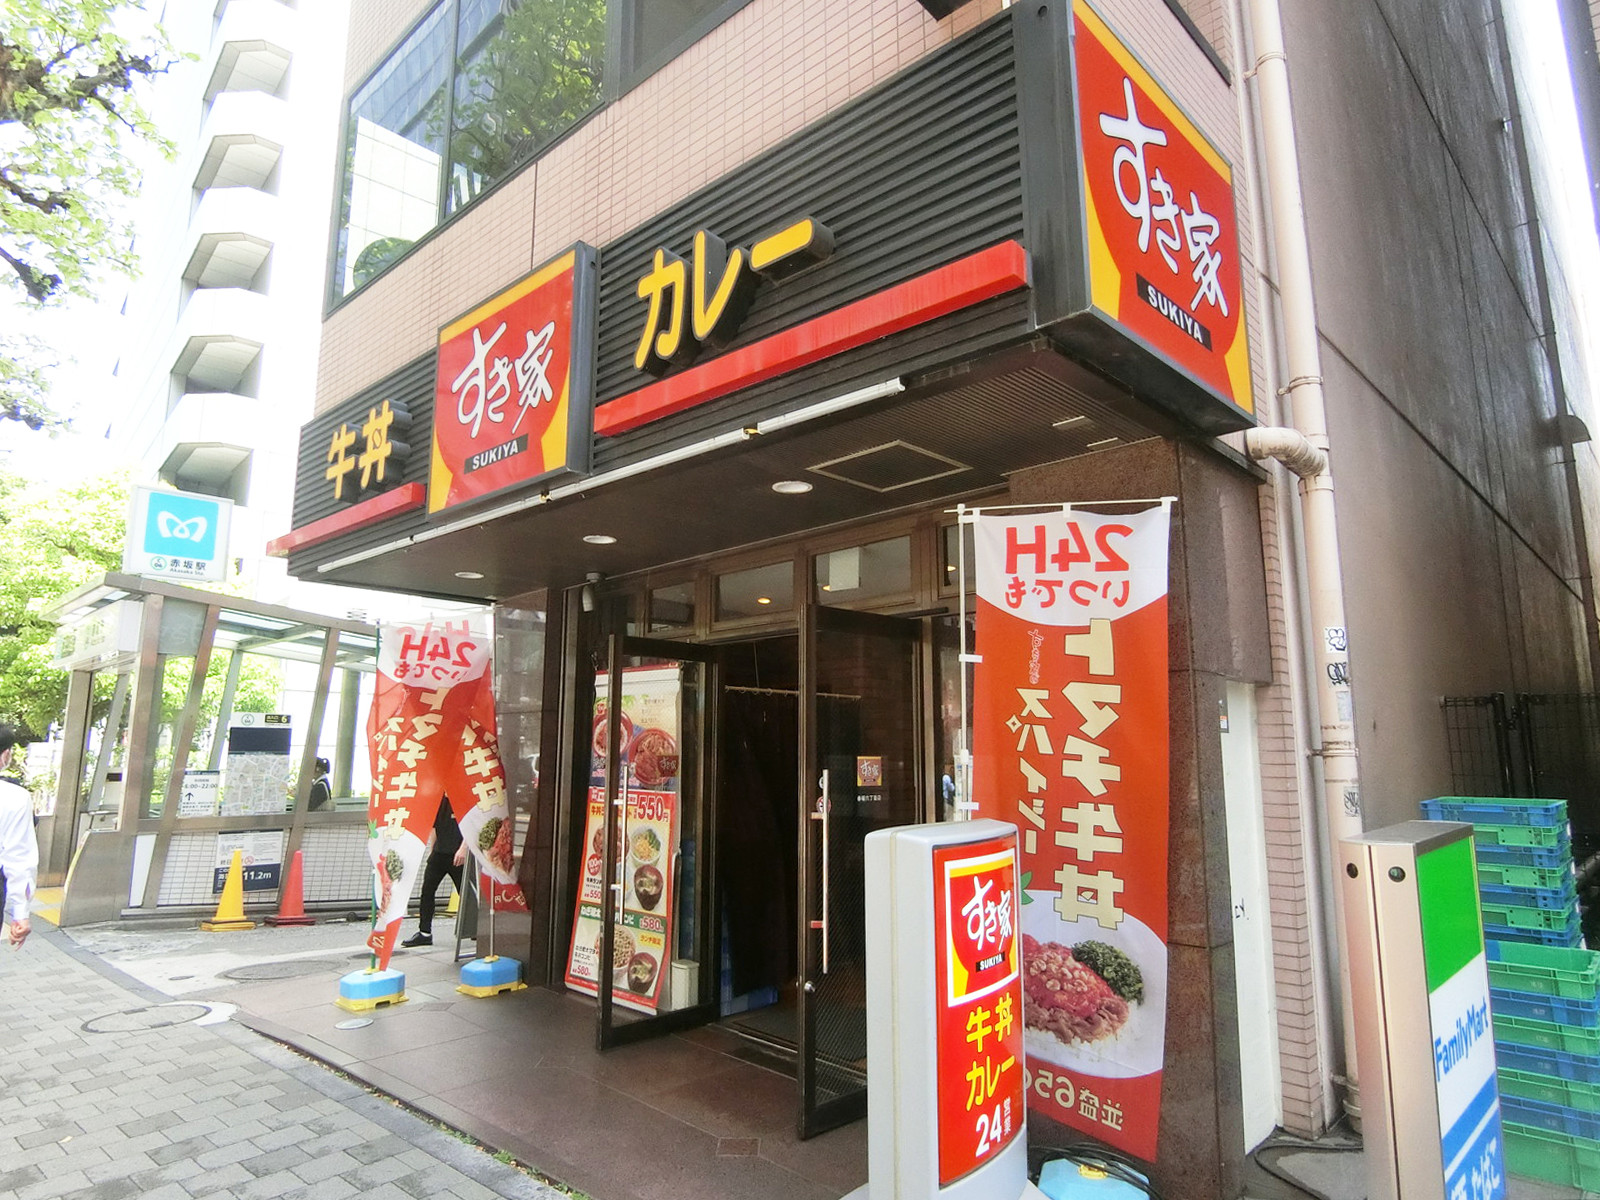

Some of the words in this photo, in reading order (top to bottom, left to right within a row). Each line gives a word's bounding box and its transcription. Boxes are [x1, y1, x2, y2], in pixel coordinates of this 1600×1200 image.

[1099, 76, 1228, 318] すき家
[634, 219, 813, 369] カレー
[1147, 283, 1204, 344] SUKIYA
[451, 321, 555, 438] すき家
[326, 400, 394, 499] 牛丼
[472, 439, 519, 470] SUKIYA
[170, 559, 206, 571] 赤坂駅
[962, 875, 1012, 950] すき家
[979, 952, 1003, 971] SUKIYA
[966, 992, 1013, 1052] 牛丼
[1434, 999, 1488, 1082] FamilyMart
[966, 1055, 1016, 1111] カレー
[975, 1104, 1002, 1157] 24
